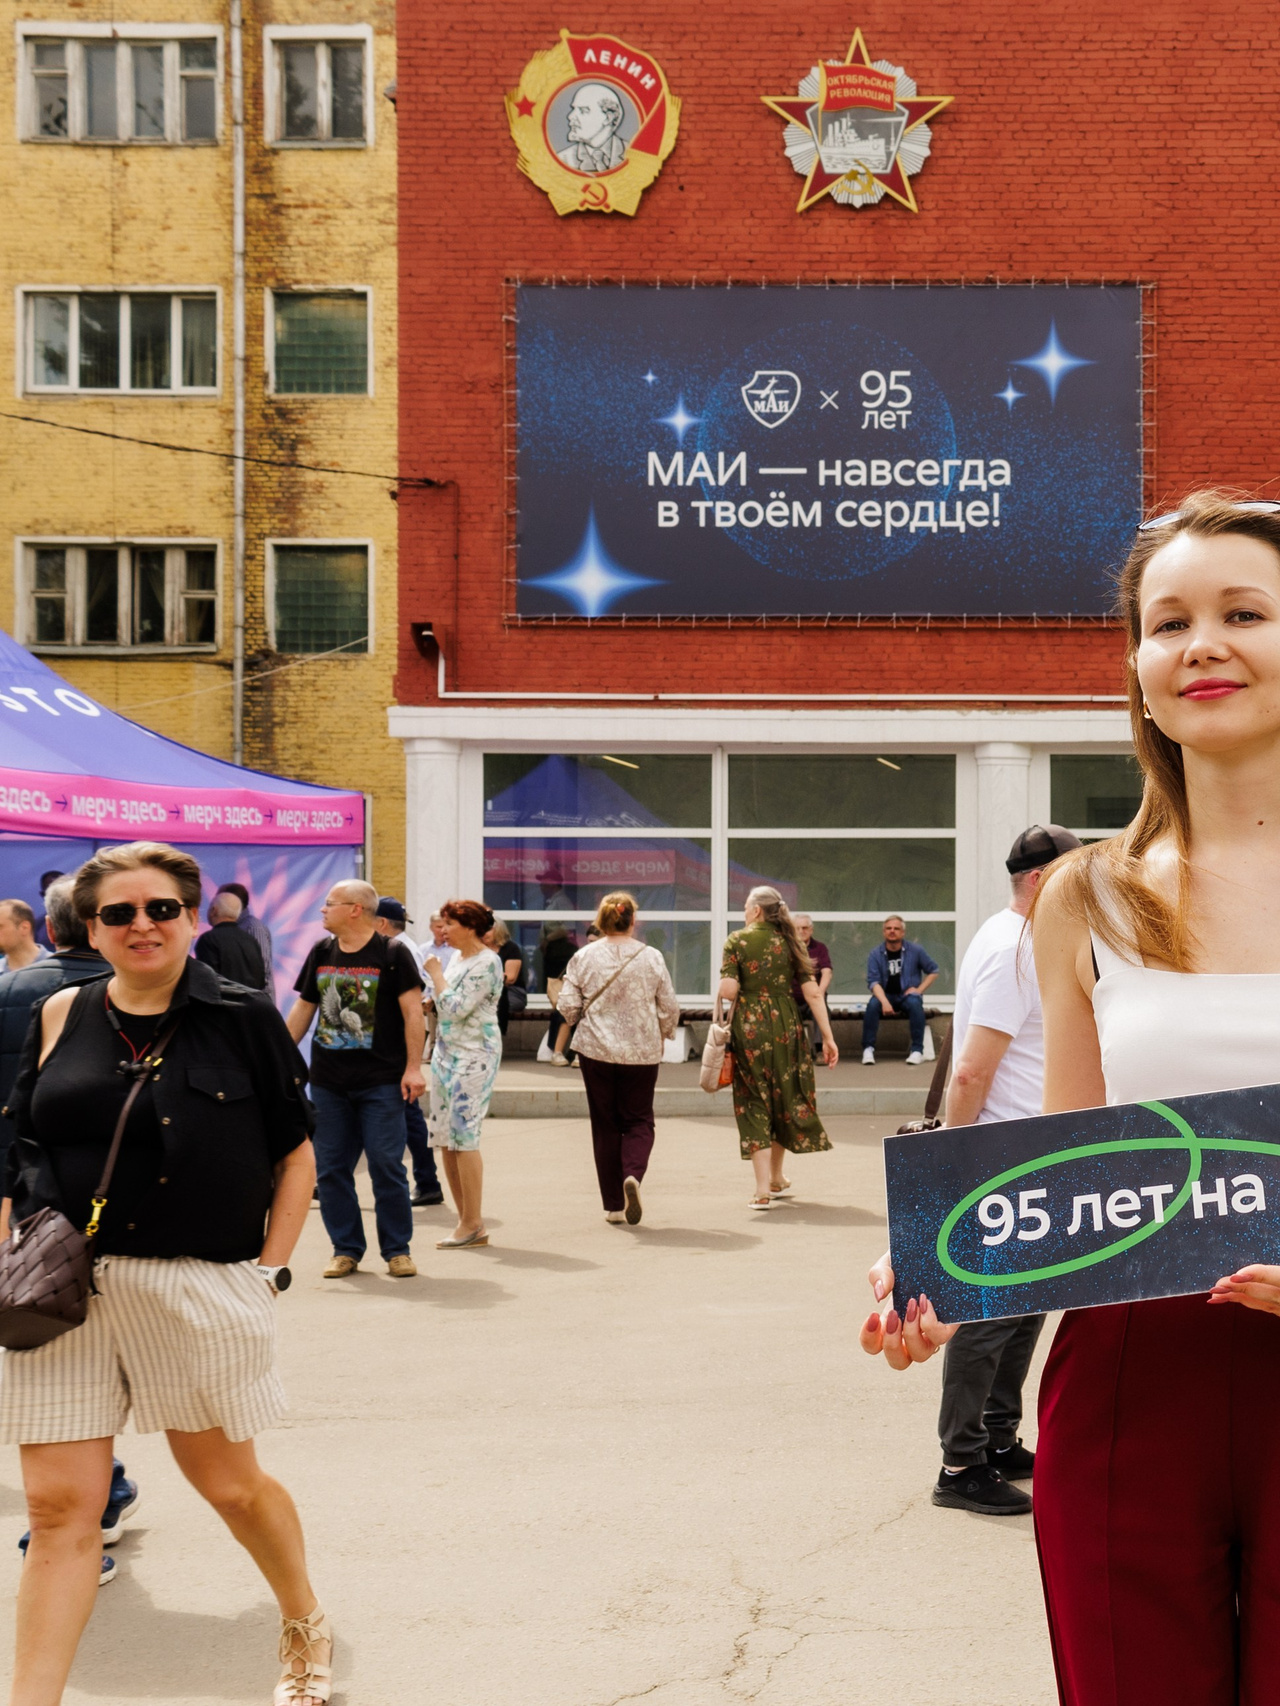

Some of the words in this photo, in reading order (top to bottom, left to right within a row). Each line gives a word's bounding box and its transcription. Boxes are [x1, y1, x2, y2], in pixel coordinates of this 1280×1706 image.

[583, 48, 656, 90] ЛЕНИН
[827, 74, 894, 91] ОКТЯБРЬСКАЯ
[829, 87, 891, 104] РЕВОЛЮЦИЯ
[859, 370, 912, 409] 95
[861, 410, 913, 430] лет
[647, 451, 747, 487] МАИ
[818, 458, 1012, 492] навсегда
[657, 501, 680, 528] в
[690, 490, 822, 528] твоём
[835, 492, 1001, 537] сердце!
[71, 795, 116, 825] мерч
[120, 799, 167, 824] здесь
[184, 804, 222, 831] мерч
[224, 806, 263, 829] здесь
[276, 809, 308, 833] мерч
[310, 810, 344, 832] здесь
[977, 1189, 1051, 1247] 95
[1066, 1183, 1174, 1235] лет
[1190, 1173, 1267, 1219] на
